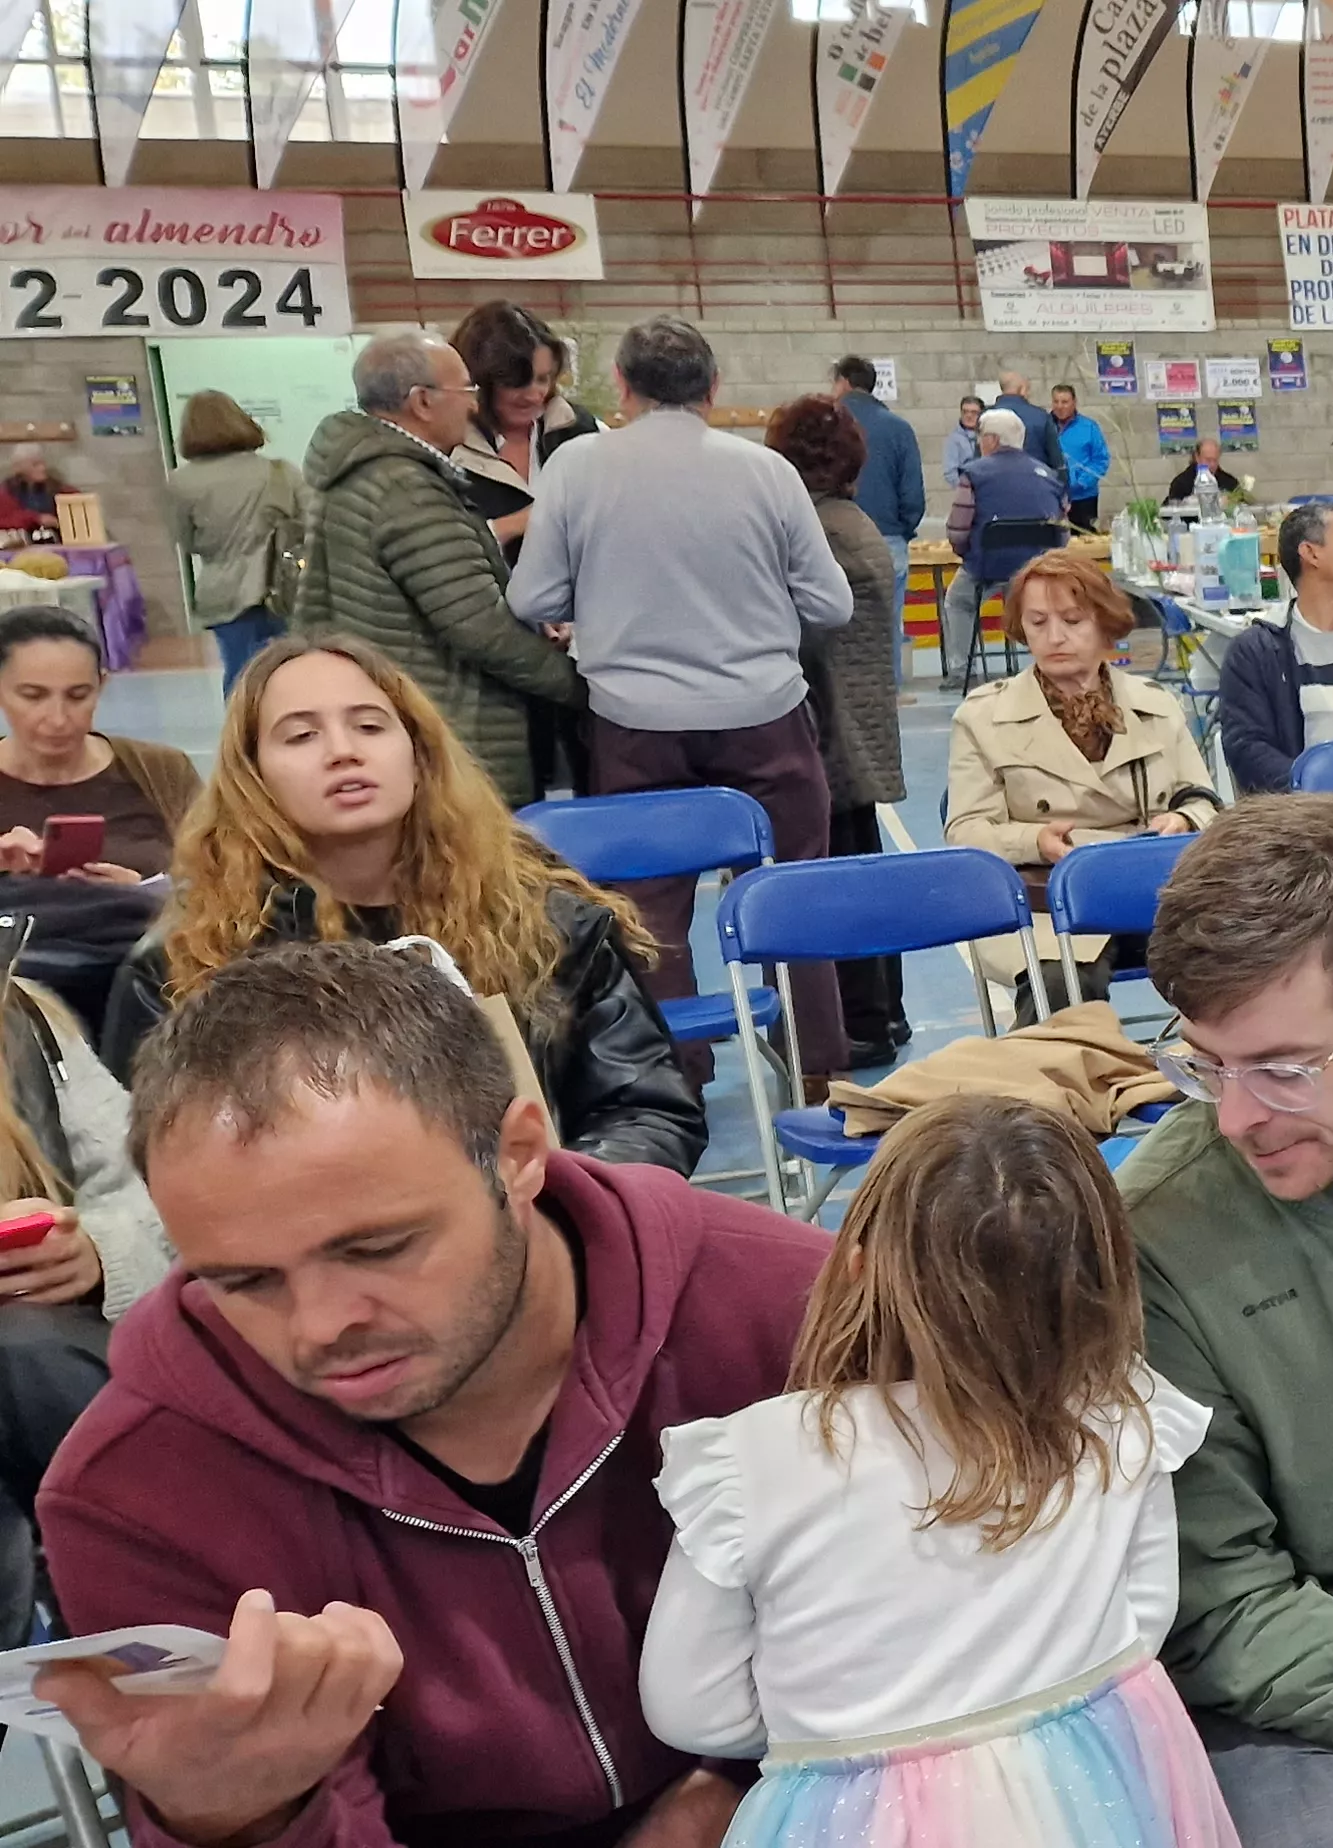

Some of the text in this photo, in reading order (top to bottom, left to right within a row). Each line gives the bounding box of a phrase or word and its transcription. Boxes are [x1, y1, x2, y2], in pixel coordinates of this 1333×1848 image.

[1080, 0, 1158, 127] de la plaza
[1092, 204, 1150, 218] VENTA
[103, 208, 324, 248] almendro
[449, 217, 568, 249] Ferrer
[986, 223, 1099, 237] PROYECTOS
[1153, 218, 1185, 235] LED
[1286, 234, 1311, 256] EN
[1036, 301, 1153, 315] ALQUILERES
[1293, 304, 1316, 324] DE
